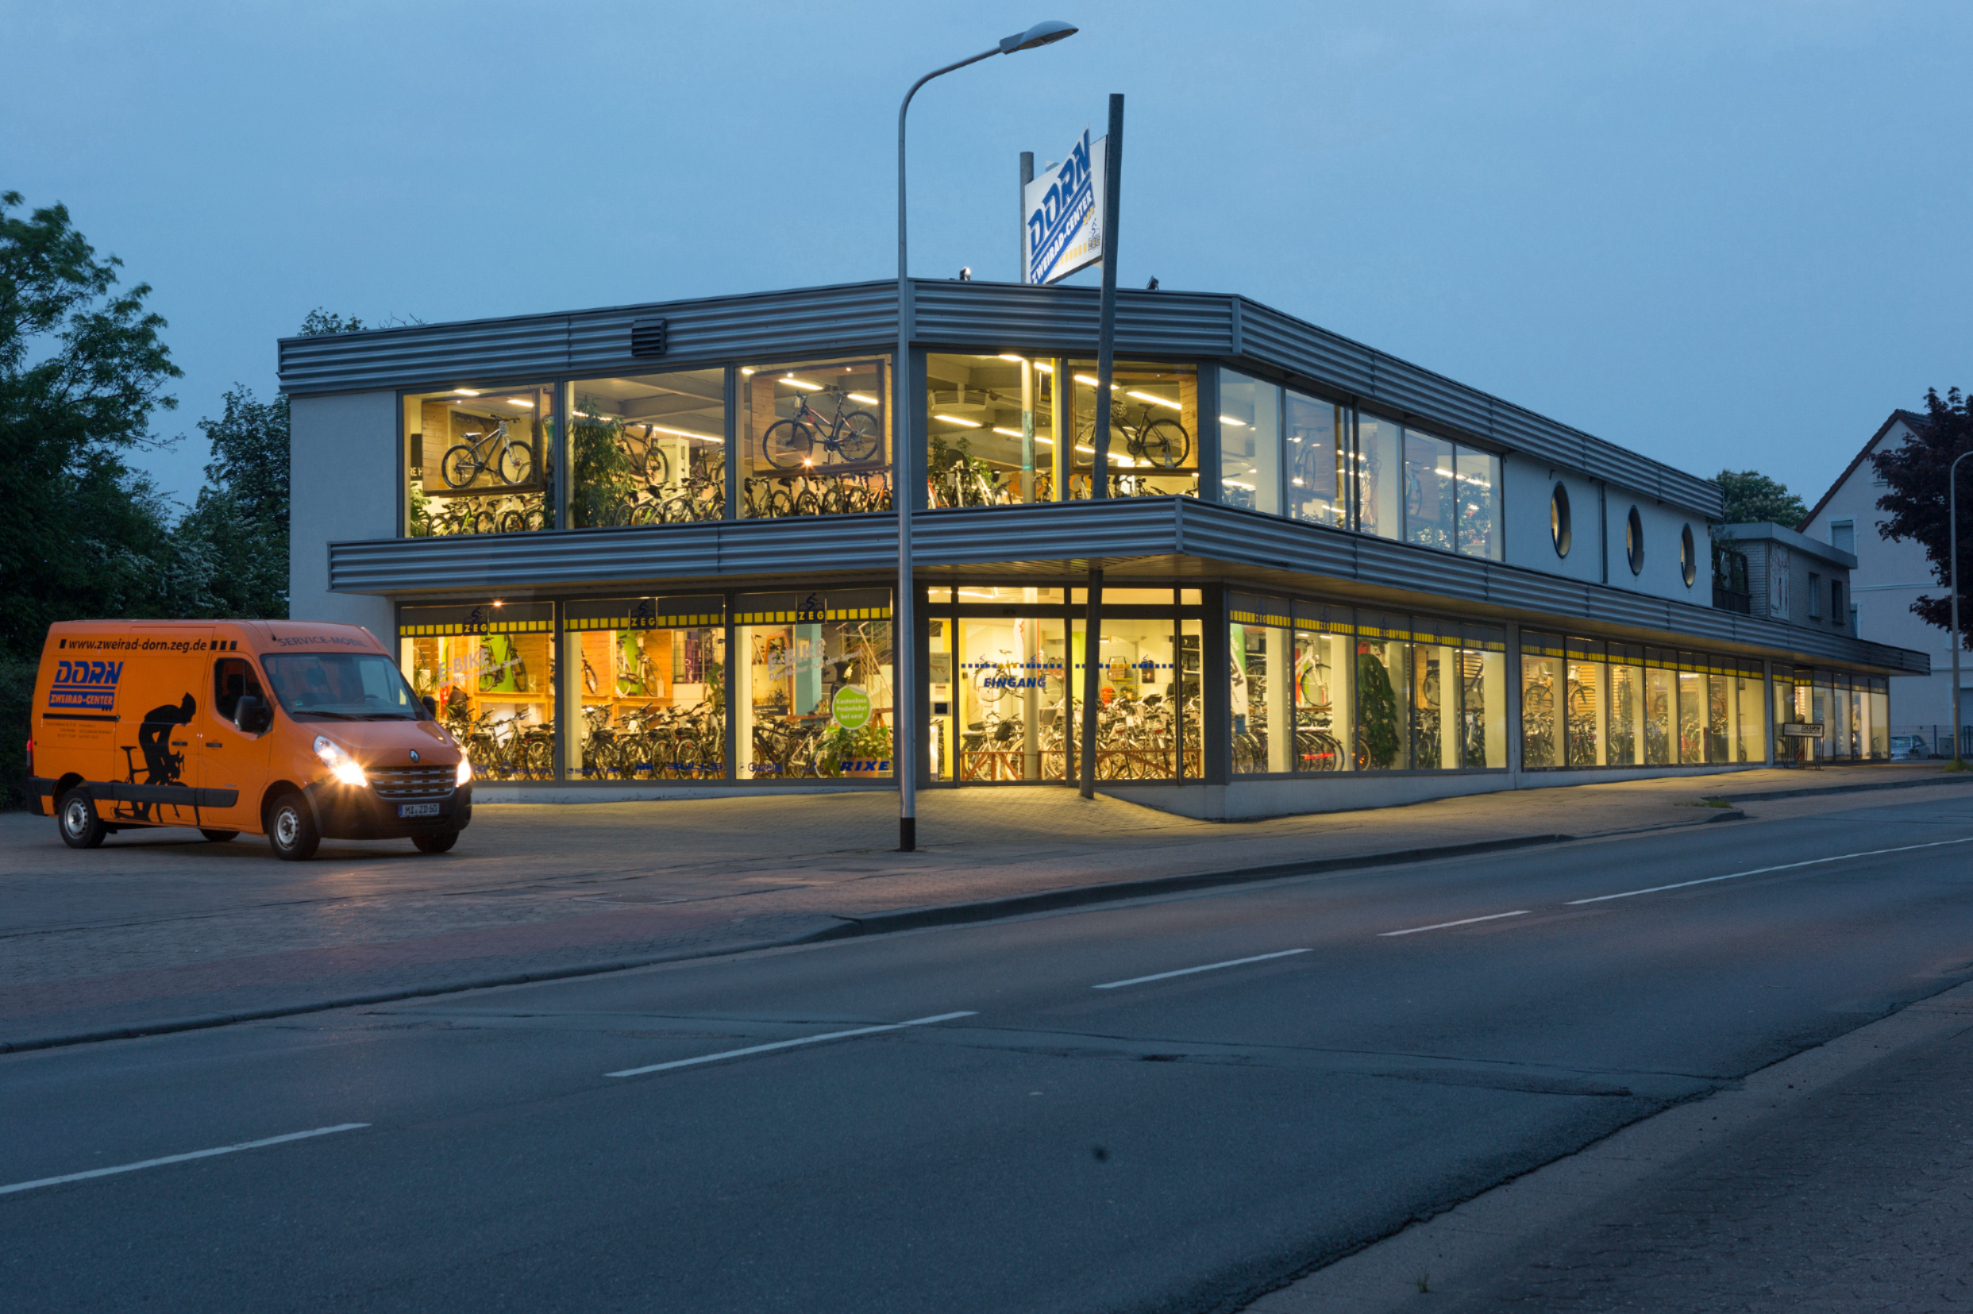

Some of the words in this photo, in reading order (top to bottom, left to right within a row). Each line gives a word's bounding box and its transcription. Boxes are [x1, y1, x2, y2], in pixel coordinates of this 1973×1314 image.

[1027, 128, 1091, 255] DORN
[1031, 188, 1094, 284] ZWEIRAD-CENTER
[1088, 236, 1101, 250] ZEG
[798, 610, 825, 621] ZEG
[1255, 614, 1267, 623] ZEG
[463, 623, 488, 633] ZEG
[631, 618, 656, 627] ZEG
[1319, 621, 1330, 630] ZEG
[68, 638, 207, 653] www.zweirad-dorn.zeg.de
[277, 636, 367, 648] SERVICE-MOBIL
[767, 640, 824, 672] E-BIKE
[438, 647, 489, 679] E-BIKE
[54, 660, 124, 684] DORN
[983, 677, 1047, 688] EINGANG
[49, 693, 113, 705] ZWEIRAD-CENTER
[836, 704, 867, 712] Probefahrt
[840, 760, 889, 772] RIXE
